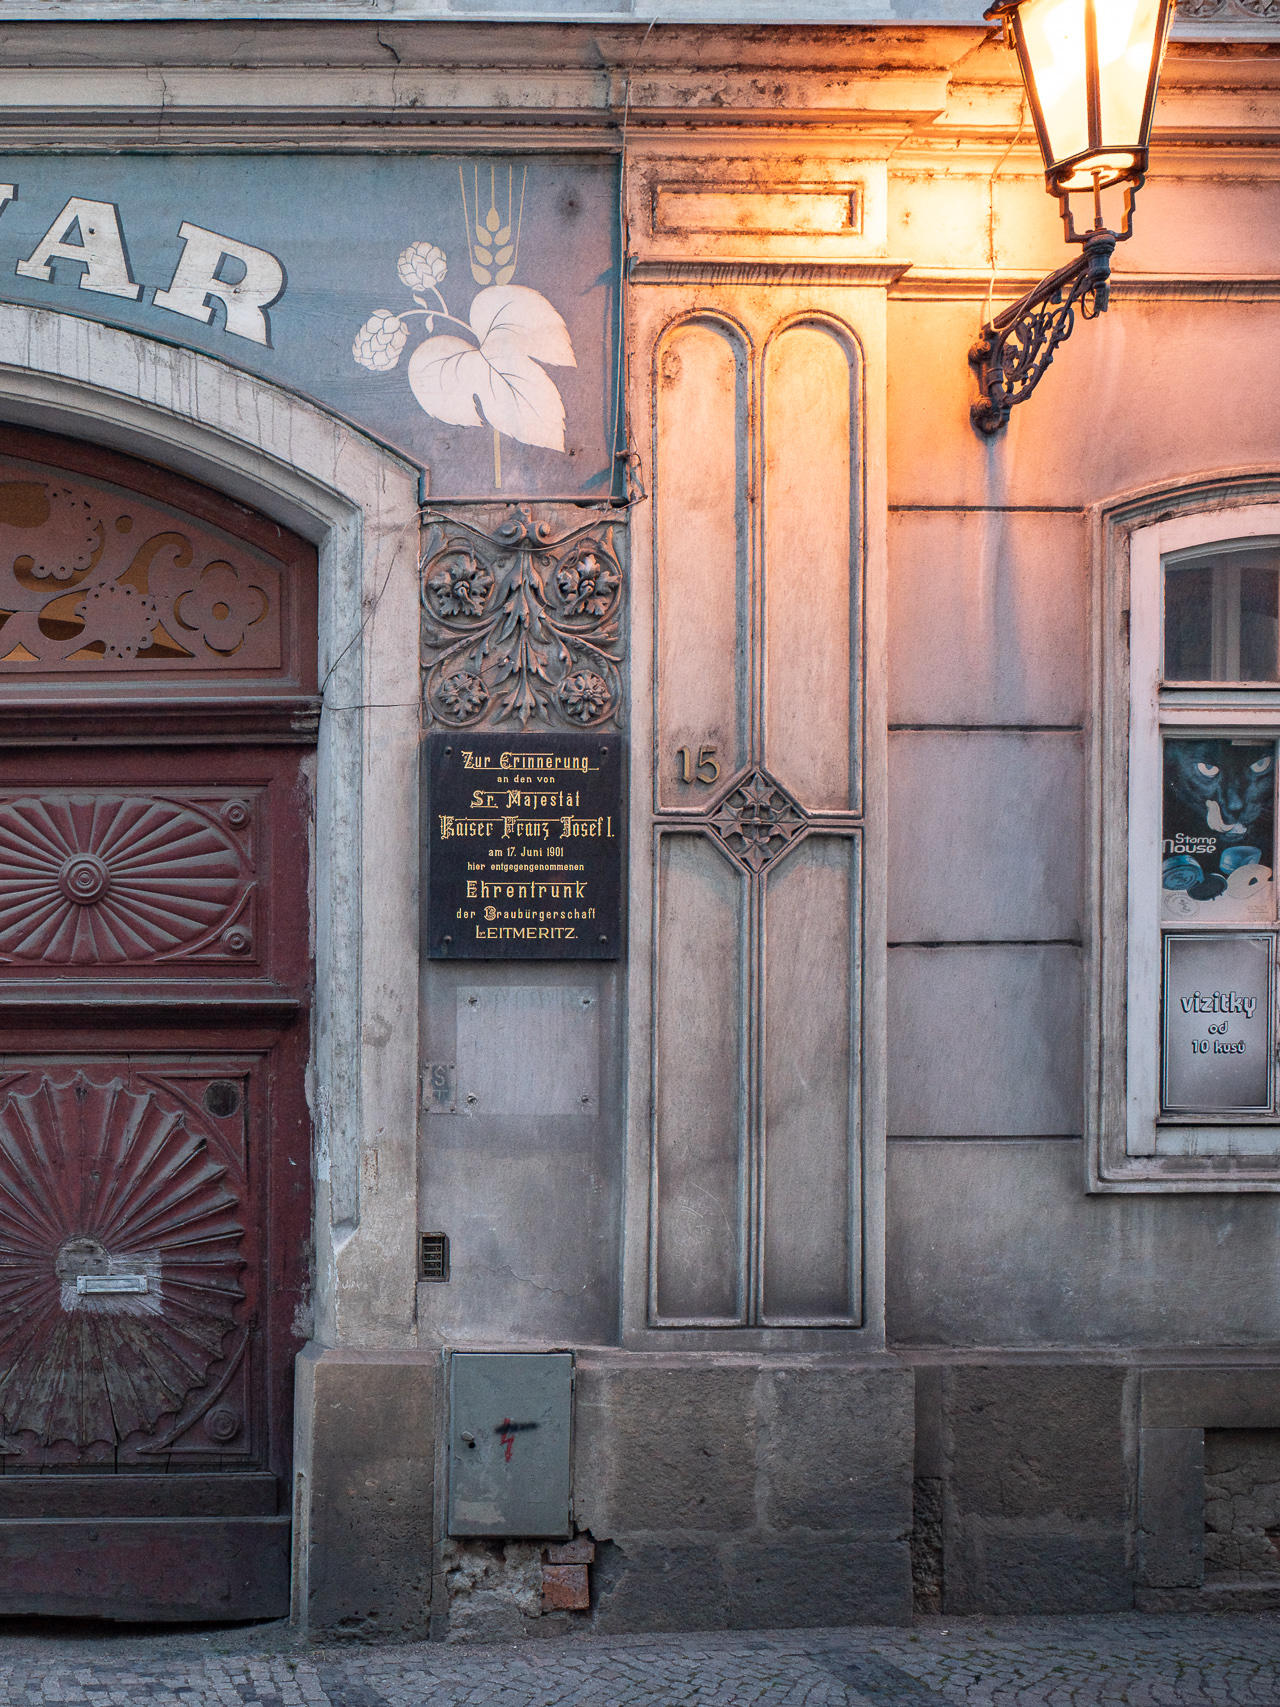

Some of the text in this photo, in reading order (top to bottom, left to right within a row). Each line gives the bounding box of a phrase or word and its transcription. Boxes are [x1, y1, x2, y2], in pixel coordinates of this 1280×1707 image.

[461, 751, 589, 773] Zur Erinnerung
[677, 745, 721, 784] 15
[497, 774, 555, 783] an den von
[470, 790, 580, 809] Sr. Majestät
[438, 815, 494, 840] Kaiser
[501, 815, 549, 840] Franz
[559, 815, 603, 839] Josef
[1175, 832, 1217, 845] Stamp
[488, 847, 564, 857] am 17. Juni 1901
[467, 862, 585, 873] hier entgegengenommenen
[466, 880, 587, 898] Ehrentrunk
[456, 905, 596, 921] der Braubürgerschaft
[475, 925, 579, 939] LEITMERITZ.
[1180, 990, 1257, 1019] vizitky
[1208, 1021, 1228, 1035] od
[1191, 1039, 1246, 1054] 10 kusů
